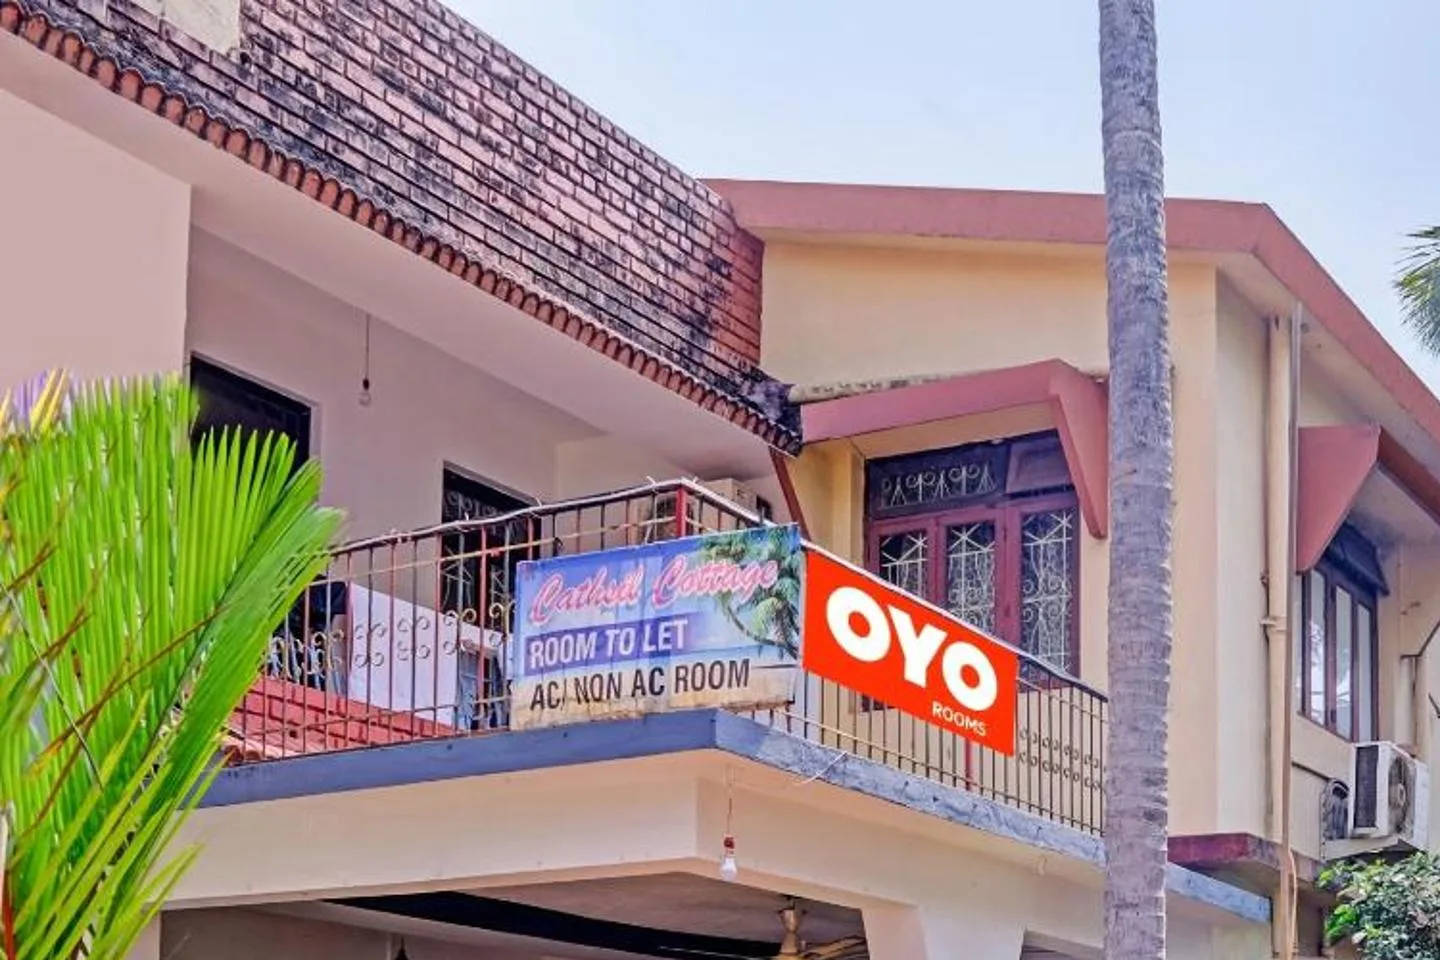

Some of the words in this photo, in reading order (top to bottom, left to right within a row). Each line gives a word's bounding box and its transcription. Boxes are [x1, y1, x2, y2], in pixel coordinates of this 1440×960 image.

[652, 554, 778, 610] Cottage
[530, 635, 596, 669] ROOM
[606, 627, 636, 657] TO
[642, 619, 689, 652] LET
[826, 586, 998, 711] OYO
[573, 671, 622, 703] NON
[631, 666, 665, 698] AC
[674, 658, 750, 694] ROOM
[932, 701, 987, 736] ROOMS
